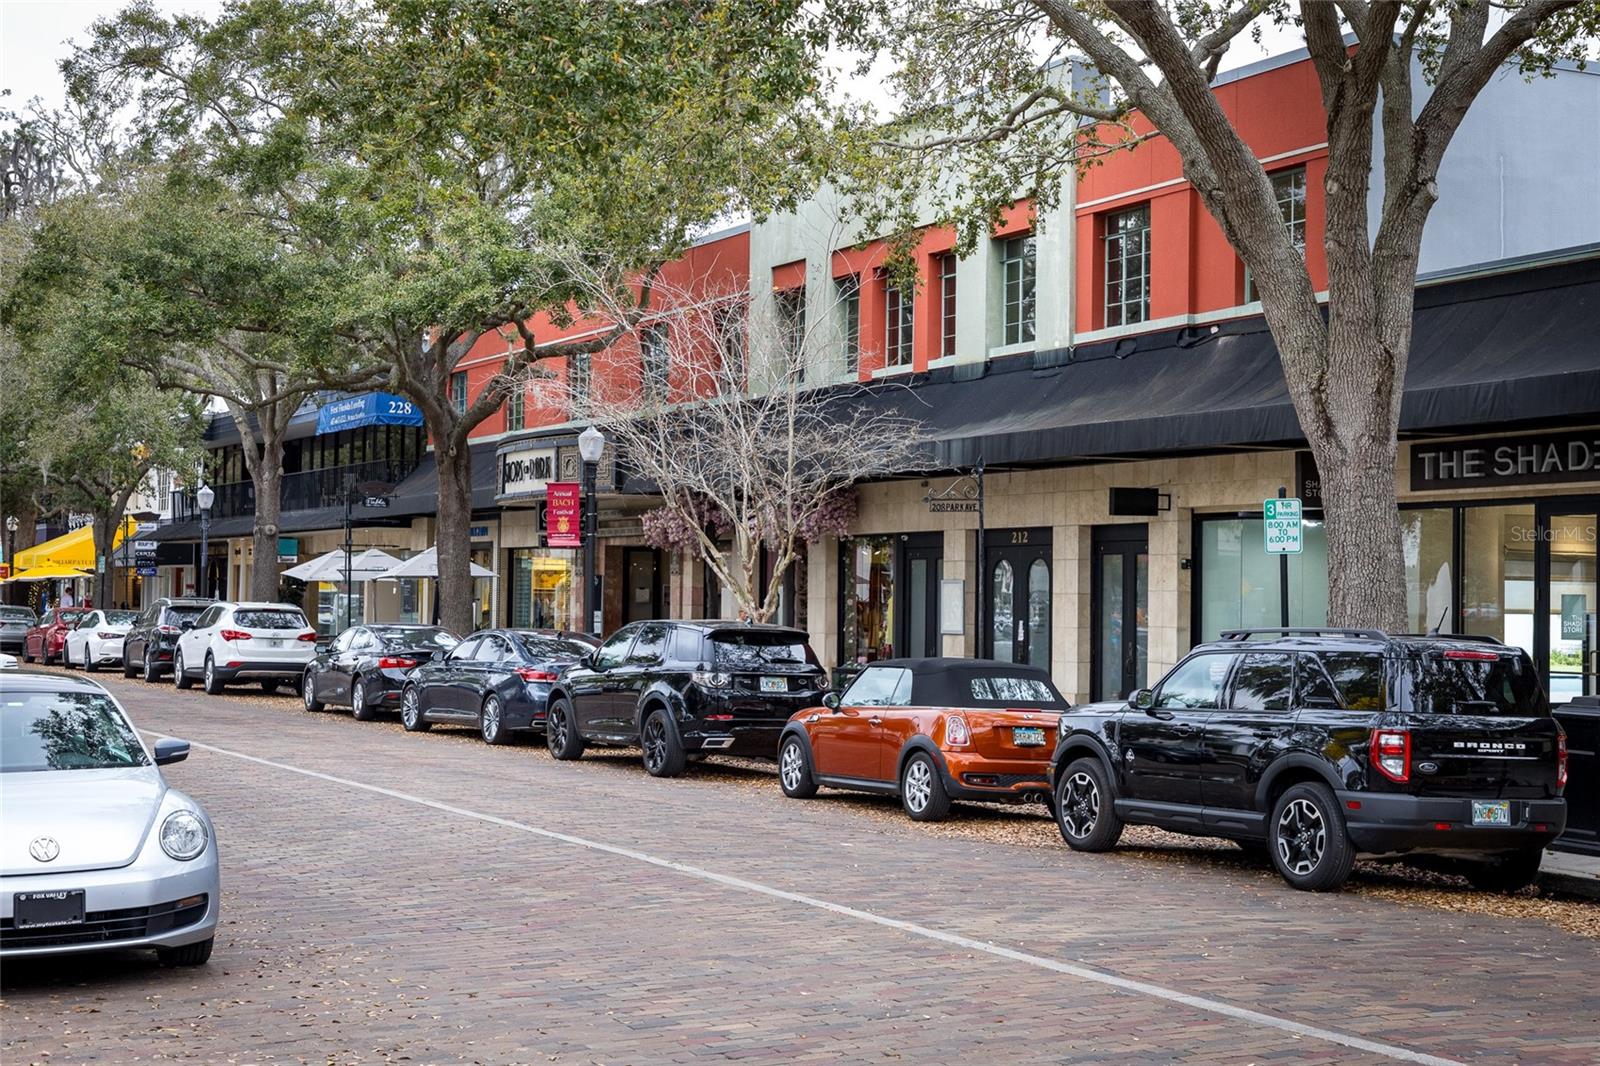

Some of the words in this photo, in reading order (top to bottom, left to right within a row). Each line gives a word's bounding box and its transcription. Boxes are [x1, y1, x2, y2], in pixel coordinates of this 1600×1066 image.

[388, 401, 412, 414] 228
[1418, 449, 1481, 480] THE
[552, 499, 574, 507] BACH
[946, 503, 964, 512] PARK
[1266, 504, 1275, 516] 3
[1286, 520, 1298, 528] AM
[1012, 532, 1028, 544] 212
[1454, 742, 1526, 750] BRONCO
